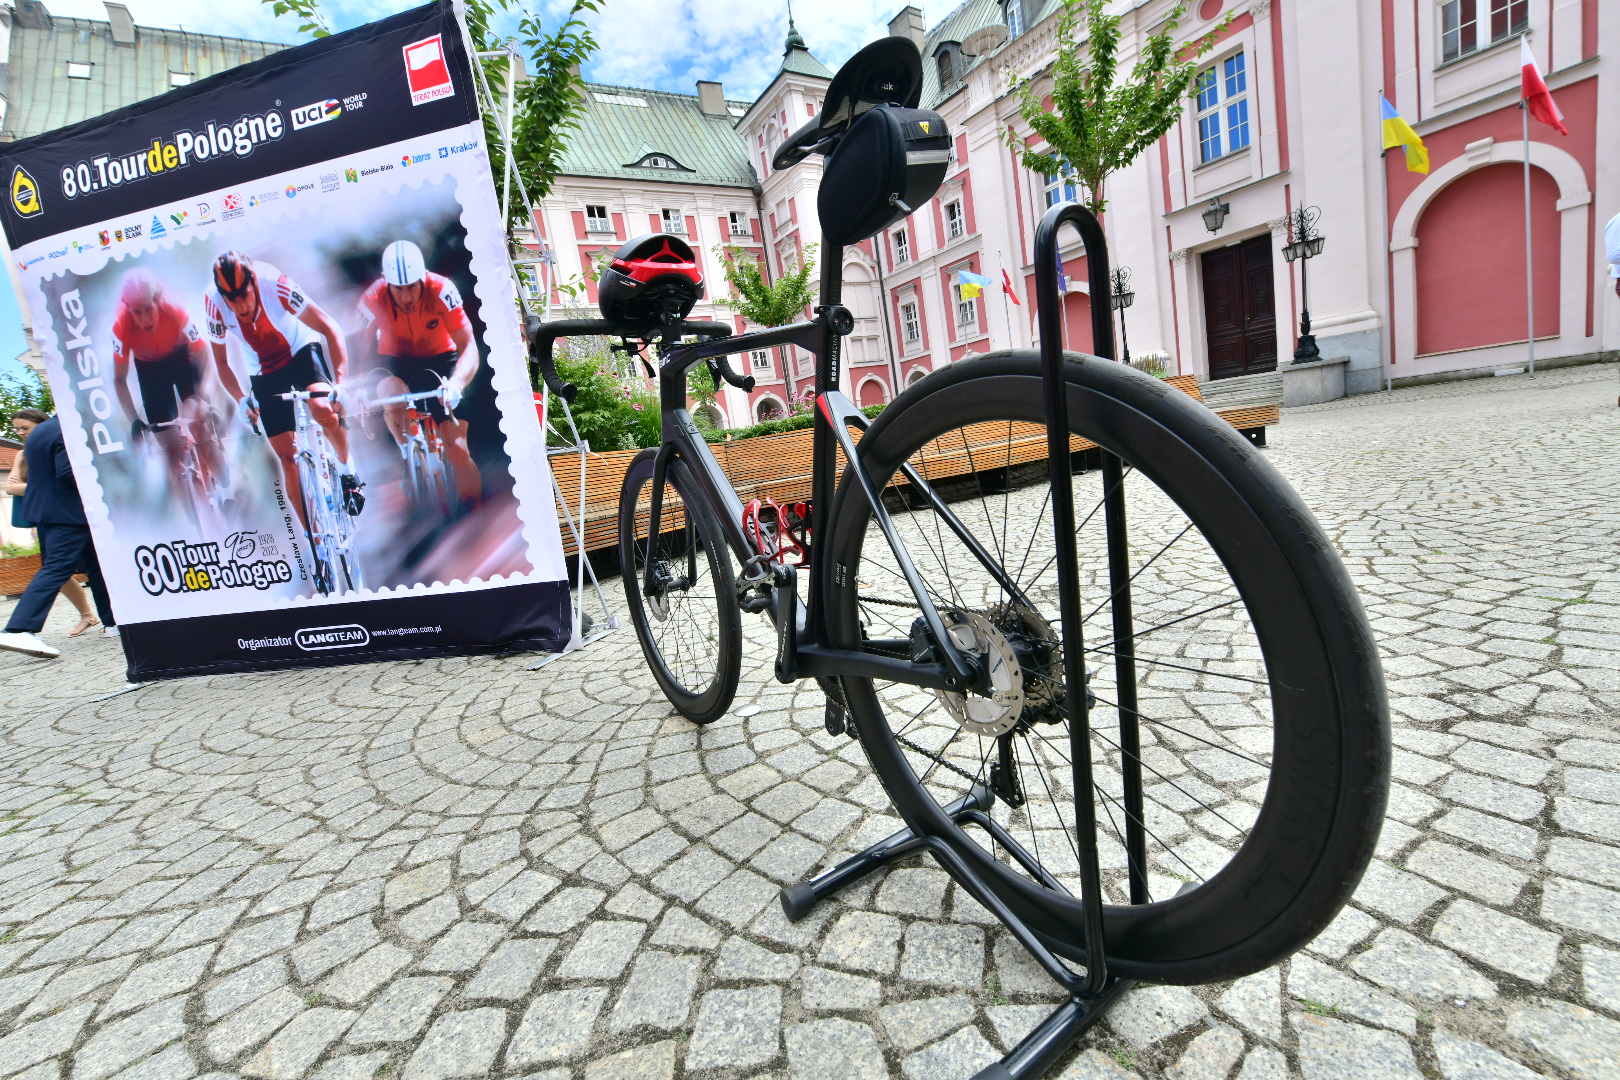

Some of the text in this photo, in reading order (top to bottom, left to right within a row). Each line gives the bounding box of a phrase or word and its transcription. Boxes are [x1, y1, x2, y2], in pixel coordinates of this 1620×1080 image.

[343, 93, 367, 105] WORLD
[413, 86, 453, 102] TERAZ POLSKA
[344, 101, 364, 112] TOUR
[295, 107, 323, 125] UCI
[450, 141, 478, 155] Kraków
[412, 153, 431, 164] Zabrze
[296, 183, 315, 192] OPOLE
[124, 224, 142, 234] DOLNY
[60, 288, 124, 454] Polska
[275, 491, 287, 512] 1980
[172, 541, 220, 567] Tour
[237, 625, 442, 651] Organizator LANGTEAM www.langteam.com.pl
